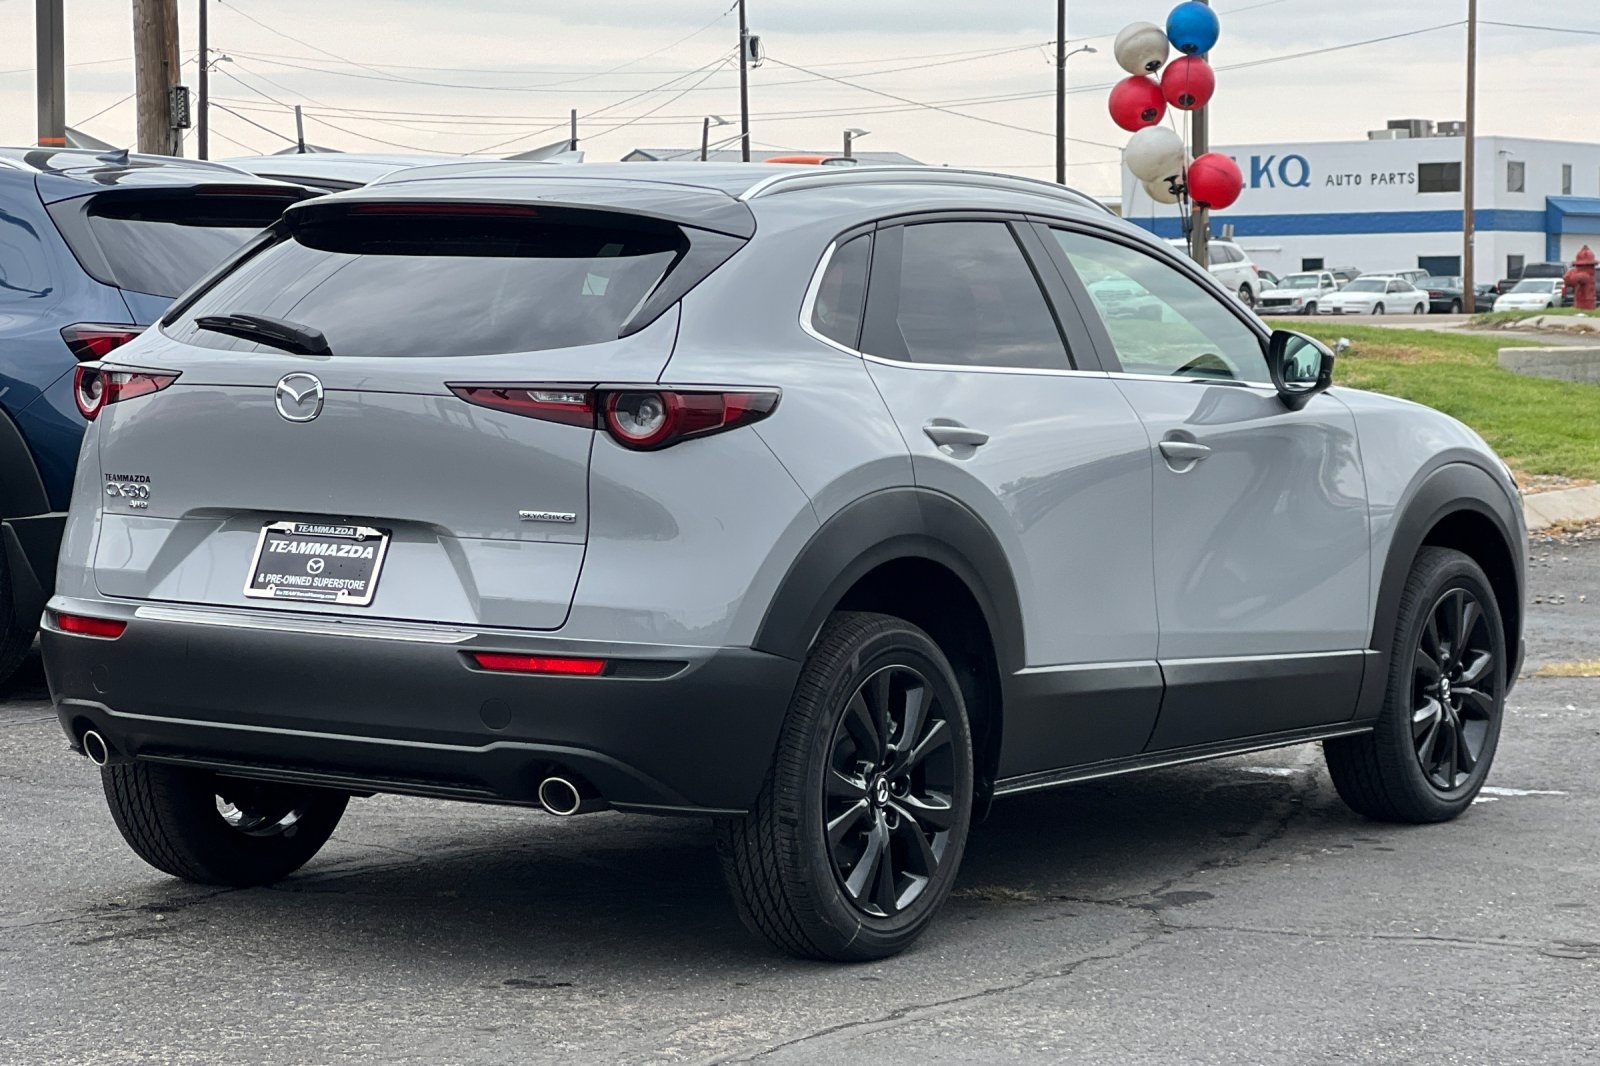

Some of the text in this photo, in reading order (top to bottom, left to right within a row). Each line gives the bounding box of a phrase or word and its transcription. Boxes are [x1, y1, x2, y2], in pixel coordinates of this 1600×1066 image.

[1231, 154, 1311, 188] KQ
[1326, 172, 1415, 187] AUTO PARTS
[105, 474, 150, 482] TEAMMAZDA
[106, 482, 150, 500] CX-30
[298, 525, 354, 535] TEAMMAZDA
[270, 540, 373, 559] TEAMMAZDA
[258, 573, 365, 590] & PRE-OWNED SUPERSTORE
